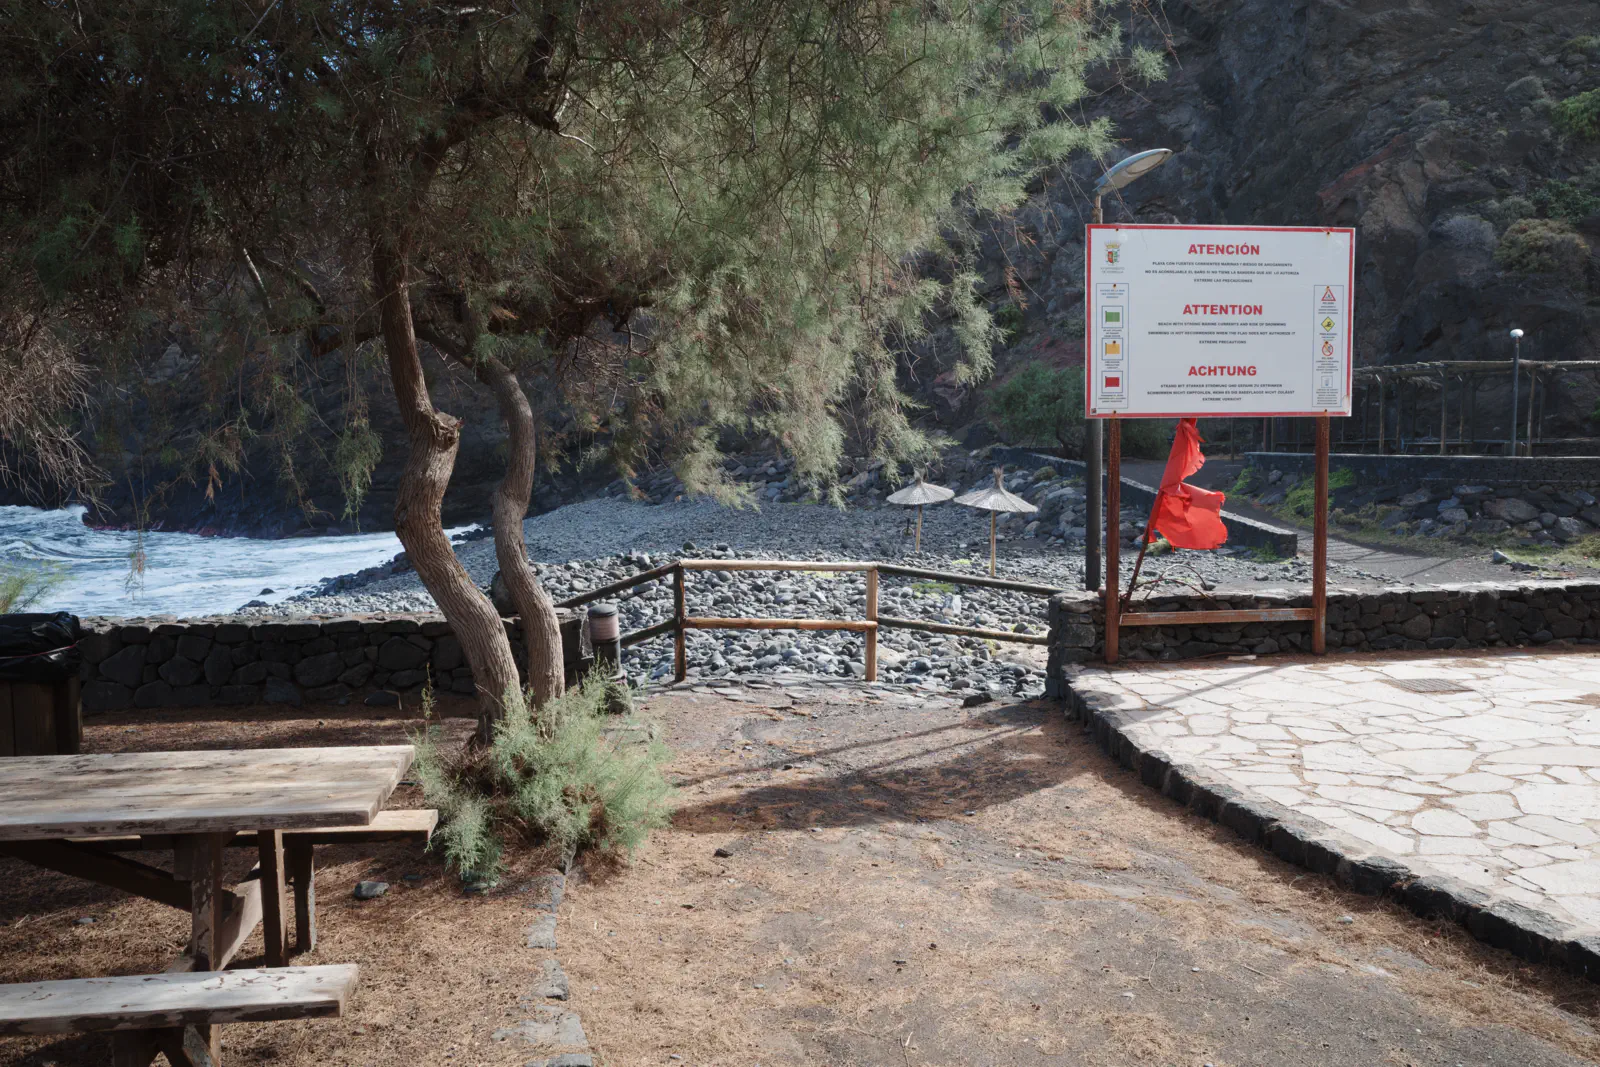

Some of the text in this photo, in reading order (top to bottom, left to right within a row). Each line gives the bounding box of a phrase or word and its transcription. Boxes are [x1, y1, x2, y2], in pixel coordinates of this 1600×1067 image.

[1188, 242, 1260, 255] ATENCIÓN
[1183, 304, 1262, 315] ATTENTION
[1188, 366, 1256, 377] ACHTUNG
